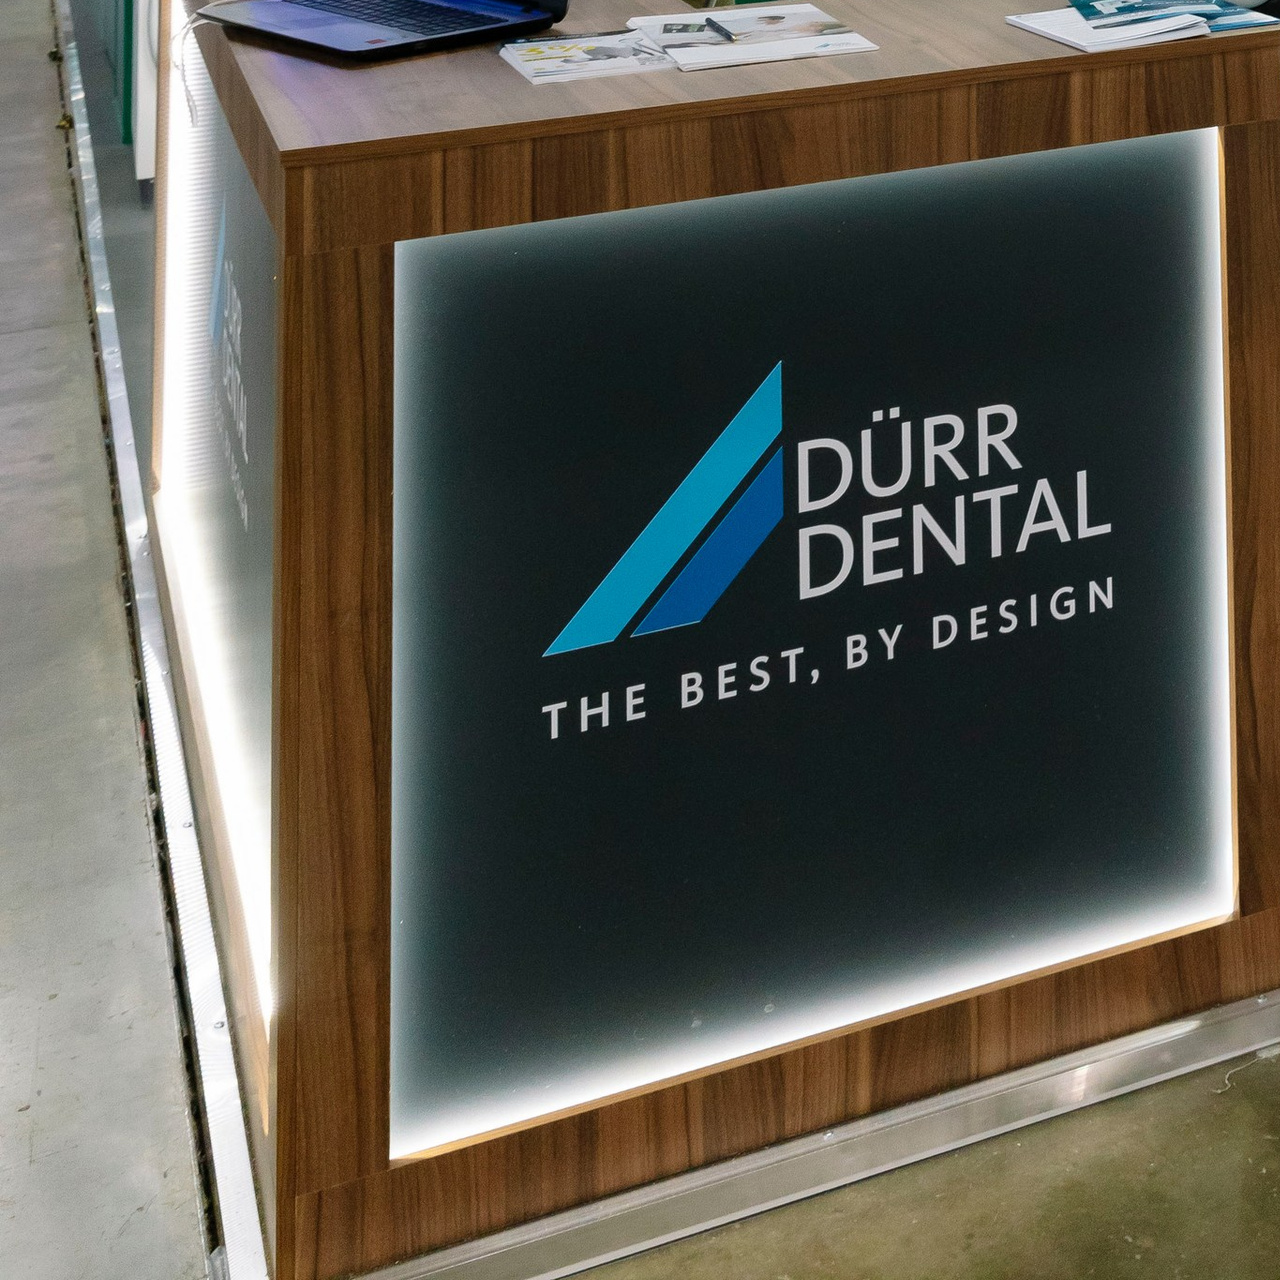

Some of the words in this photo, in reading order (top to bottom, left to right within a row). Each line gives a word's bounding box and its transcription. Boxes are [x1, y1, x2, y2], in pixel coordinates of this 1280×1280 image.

[797, 403, 1022, 514] DÜRR
[798, 470, 1112, 600] DENTAL
[541, 683, 647, 740] THE
[681, 647, 821, 709] BEST,
[846, 625, 903, 671] BY
[932, 576, 1114, 650] DESIGN
